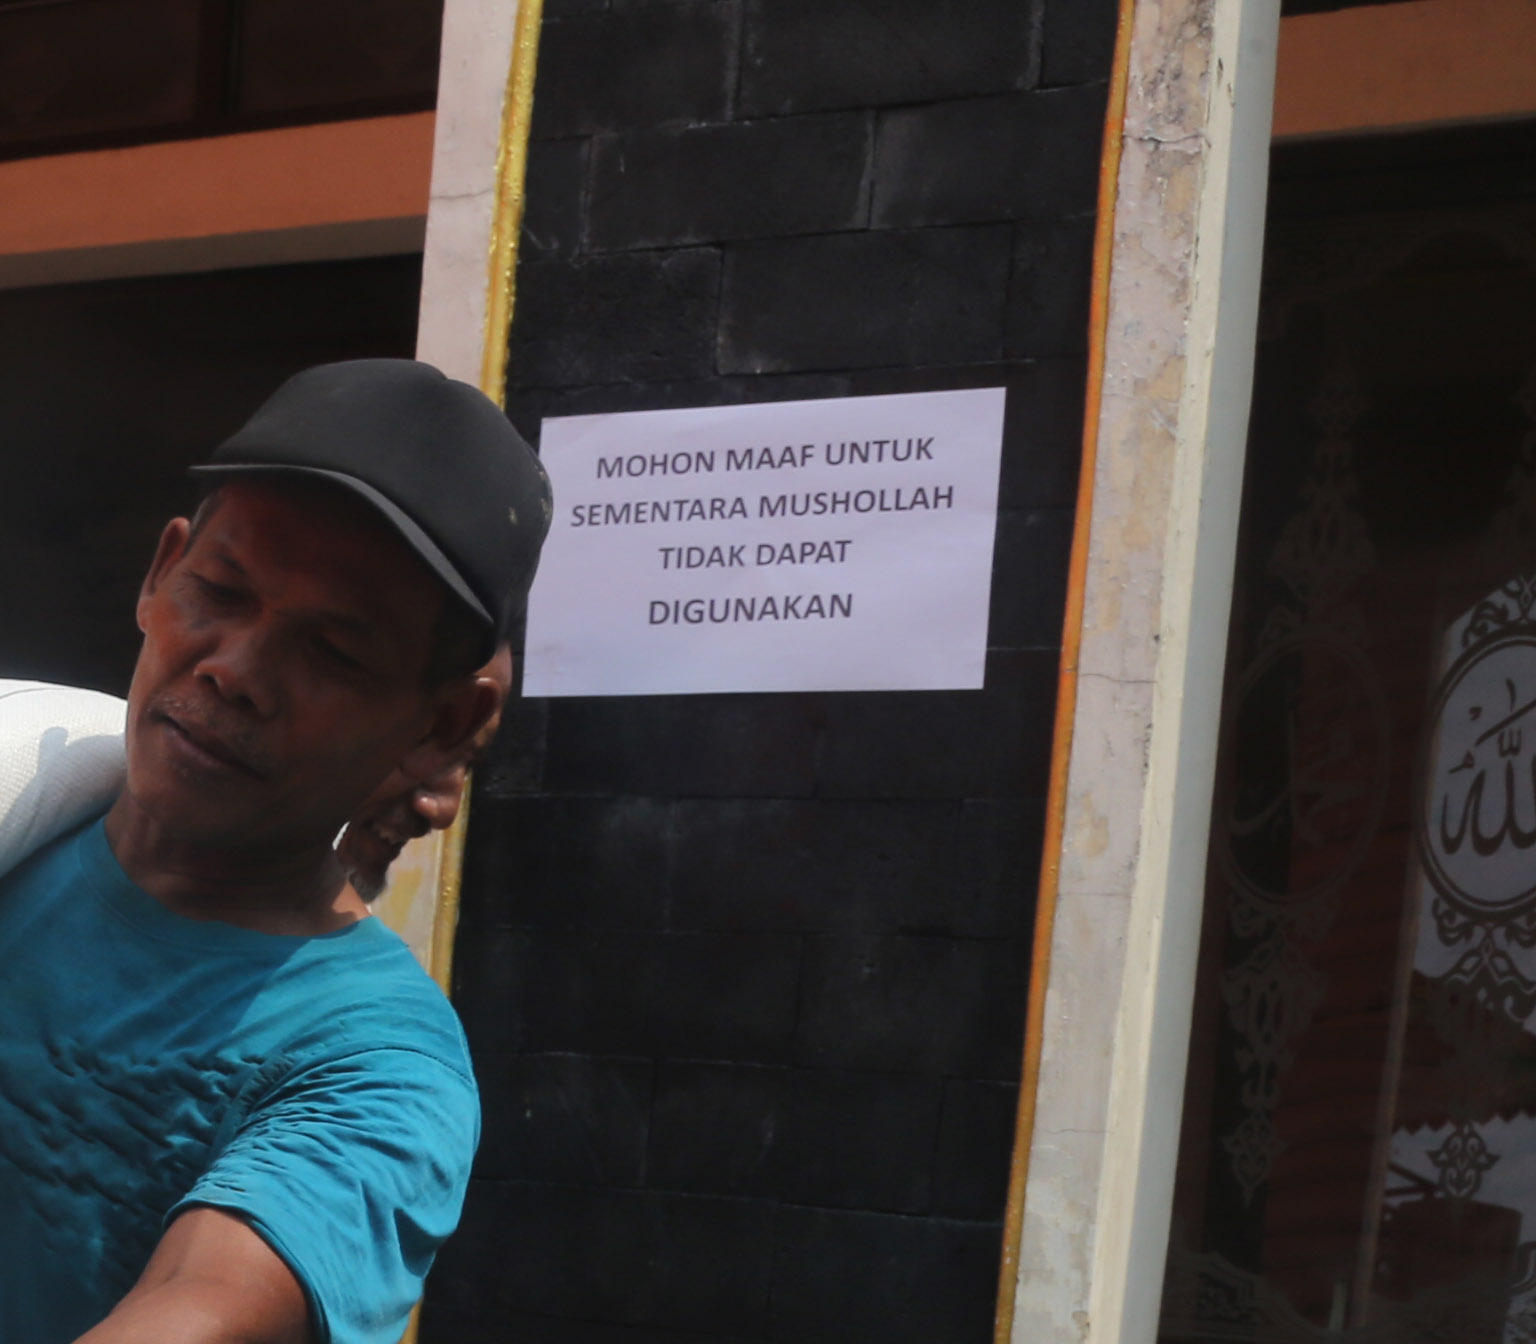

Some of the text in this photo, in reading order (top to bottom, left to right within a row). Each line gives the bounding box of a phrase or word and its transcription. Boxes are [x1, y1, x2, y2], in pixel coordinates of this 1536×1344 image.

[596, 437, 934, 479] MOHON MAAF UNTUK
[570, 485, 954, 528] SEMENTARA MUSHOLLAH
[659, 540, 852, 570] TIDAK DAPAT
[648, 593, 853, 626] DIGUNAKAN
